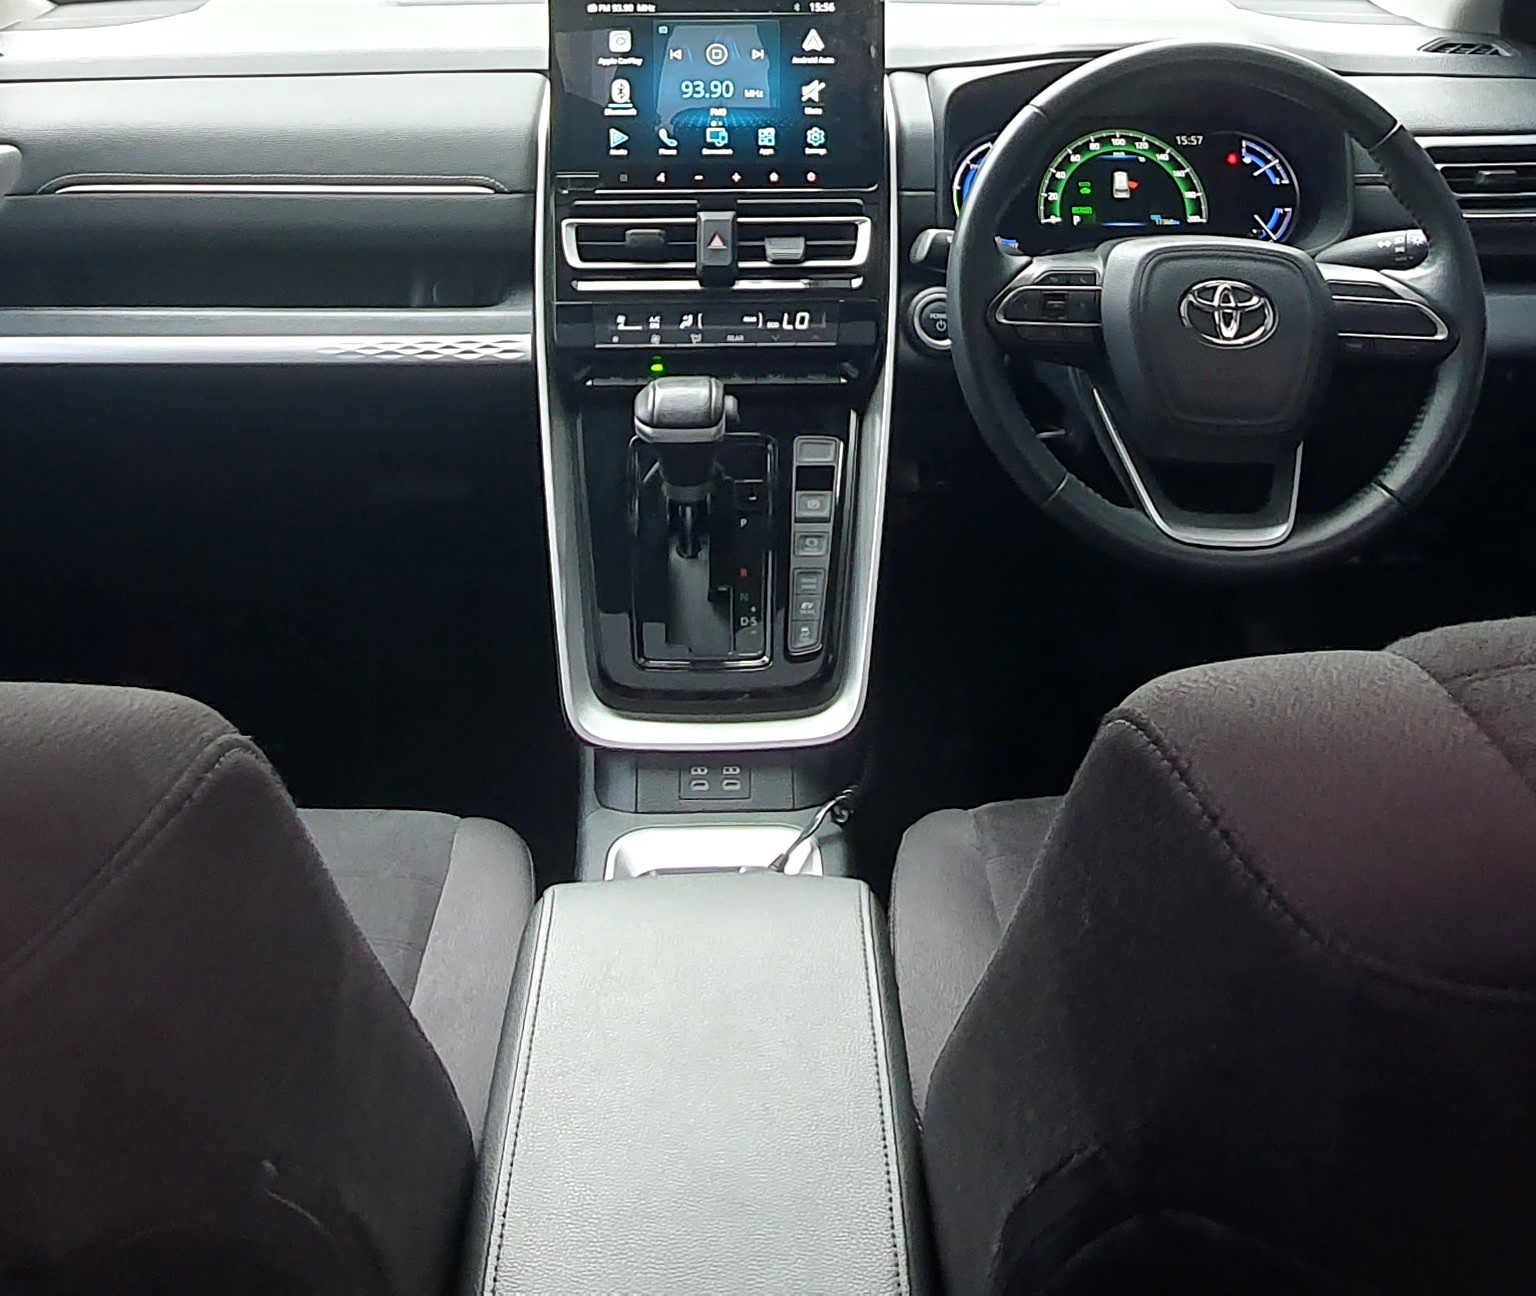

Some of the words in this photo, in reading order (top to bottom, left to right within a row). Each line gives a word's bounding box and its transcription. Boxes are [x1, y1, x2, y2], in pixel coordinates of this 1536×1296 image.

[598, 4, 611, 13] FM
[809, 2, 836, 13] 15:56
[681, 80, 734, 99] 93.90
[744, 89, 764, 98] MHz
[1111, 138, 1126, 146] 100
[1175, 135, 1204, 146] 15:57
[1089, 142, 1100, 151] 80
[1135, 141, 1149, 150] 120
[1070, 154, 1081, 162] 60
[1047, 192, 1058, 201] 20
[1072, 215, 1081, 226] P
[782, 312, 810, 330] LO
[740, 518, 748, 528] P
[740, 593, 750, 602] N
